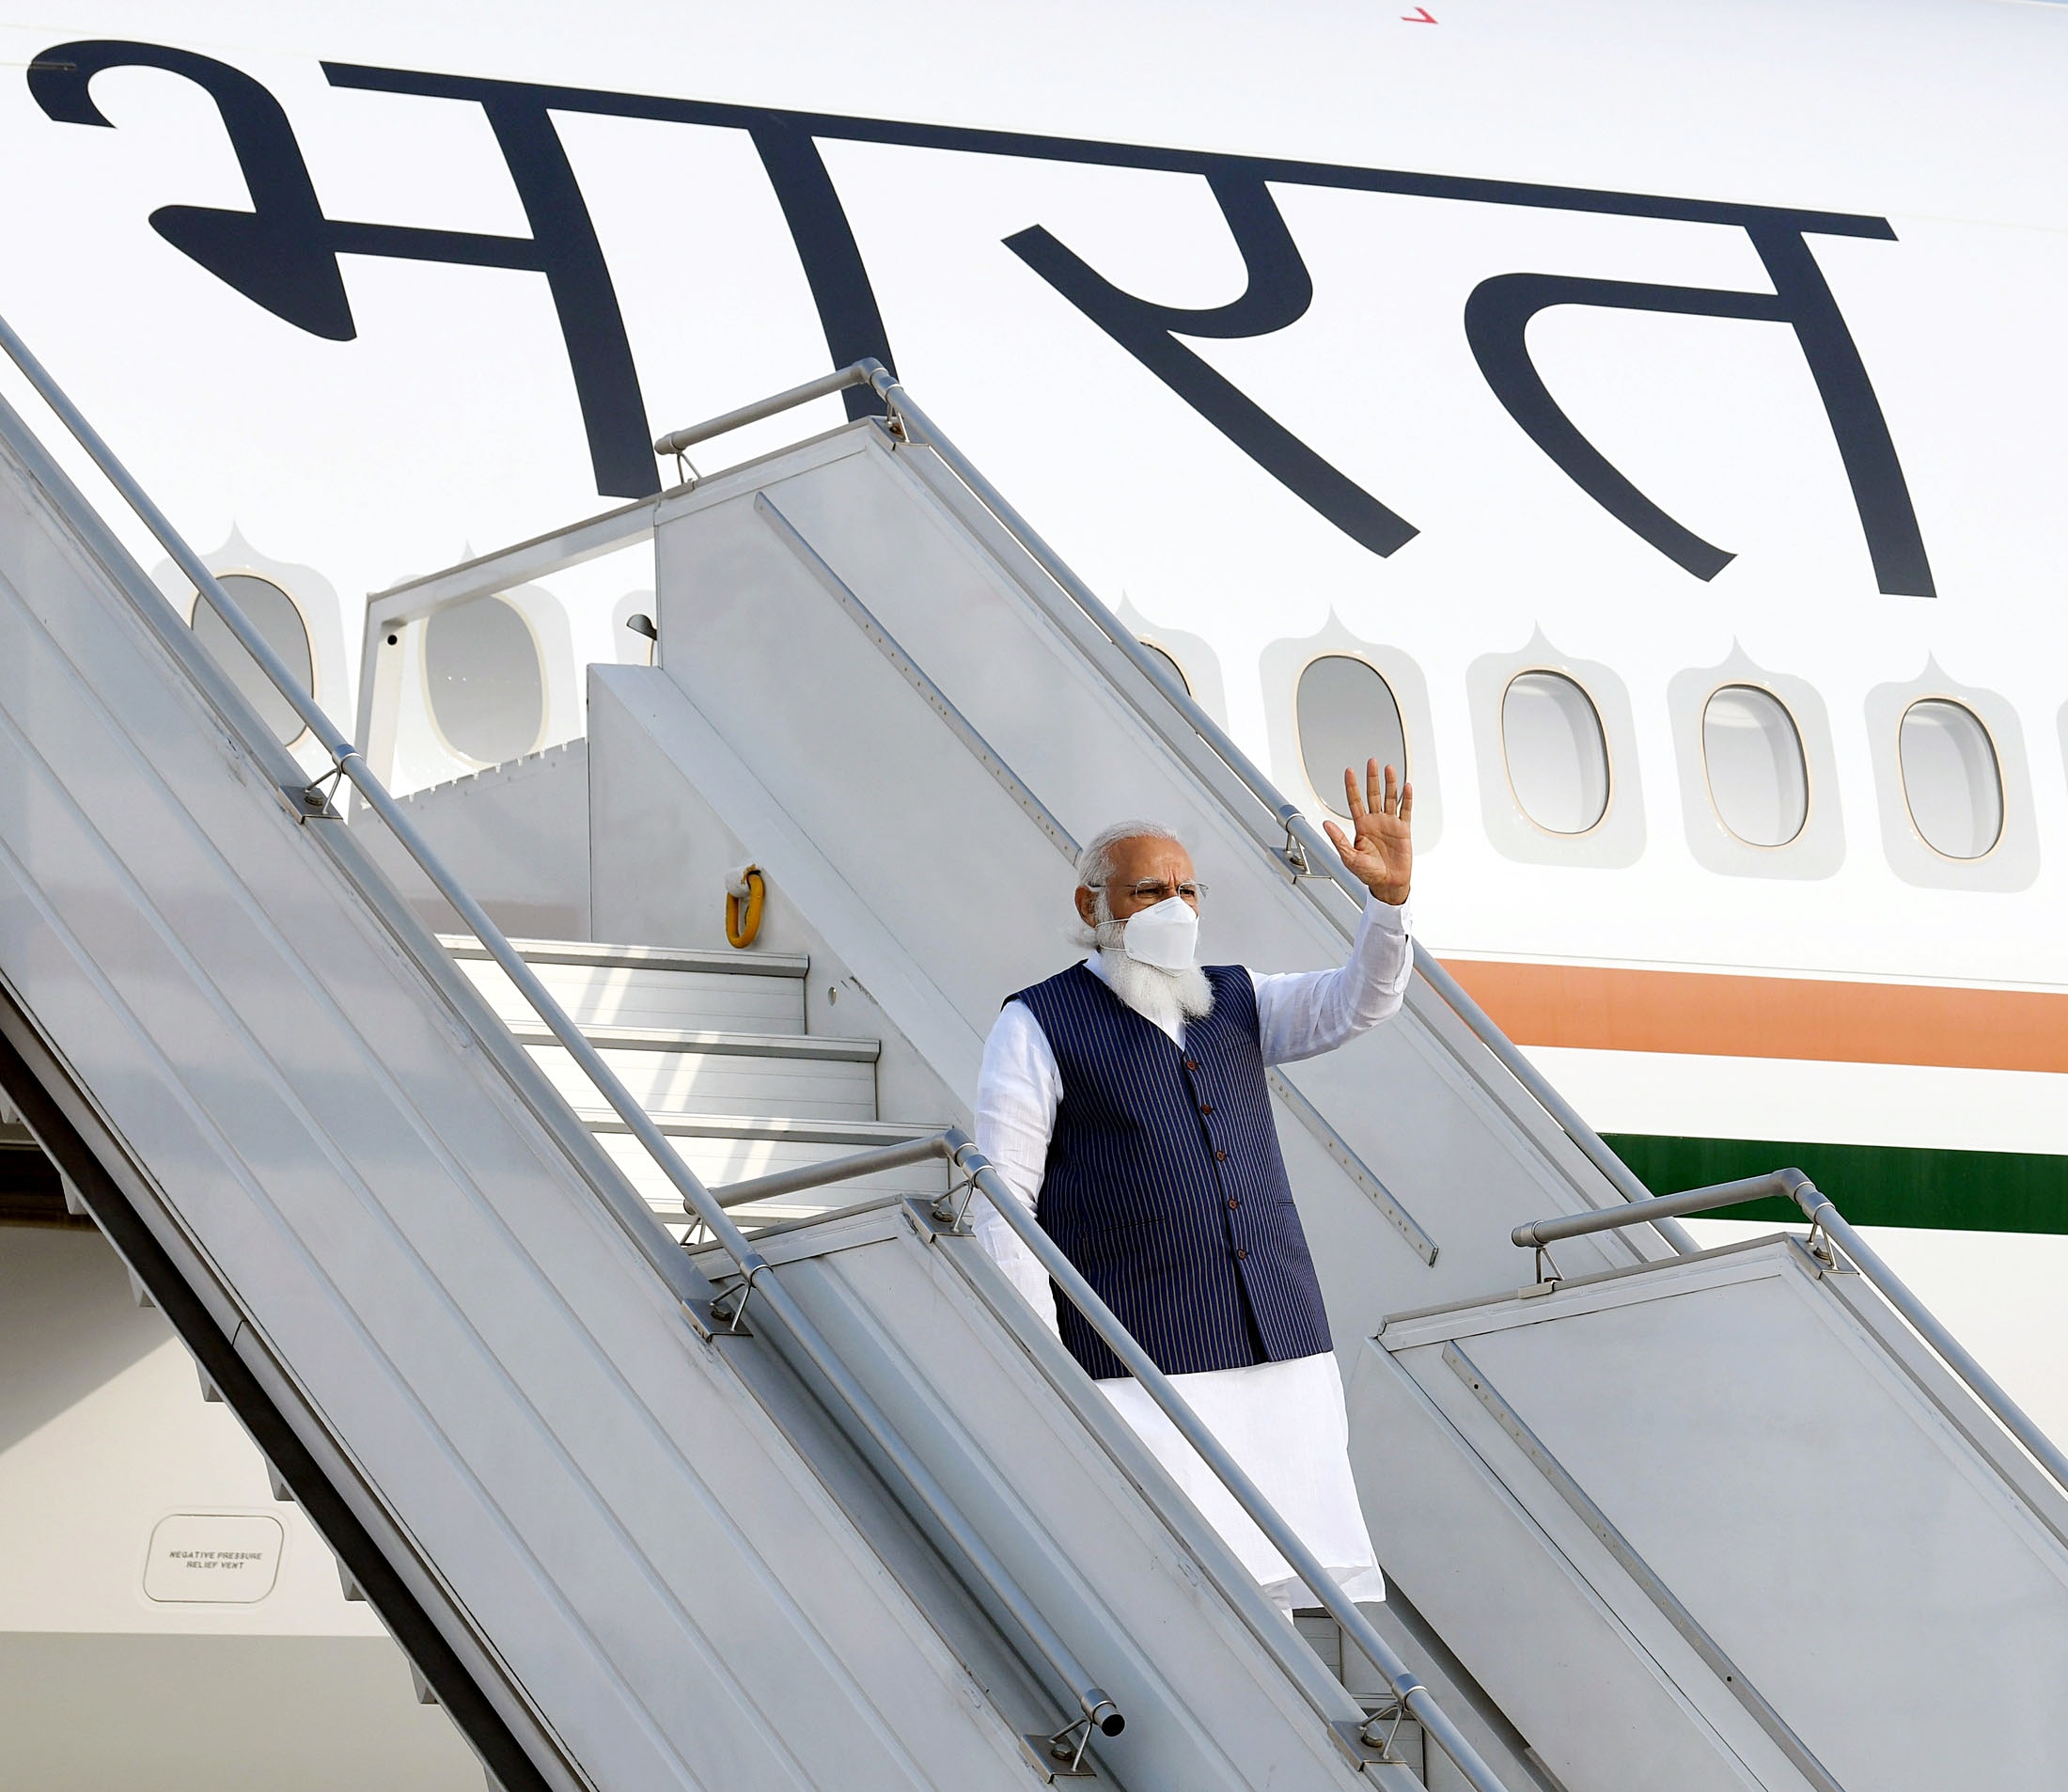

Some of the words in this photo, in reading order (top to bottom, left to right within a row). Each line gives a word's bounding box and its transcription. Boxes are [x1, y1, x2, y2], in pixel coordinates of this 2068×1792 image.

[26, 39, 1937, 599] भारत
[169, 1550, 214, 1559] NEGATIVE
[217, 1552, 263, 1561] PRESSURE
[186, 1561, 218, 1569] RELIEF
